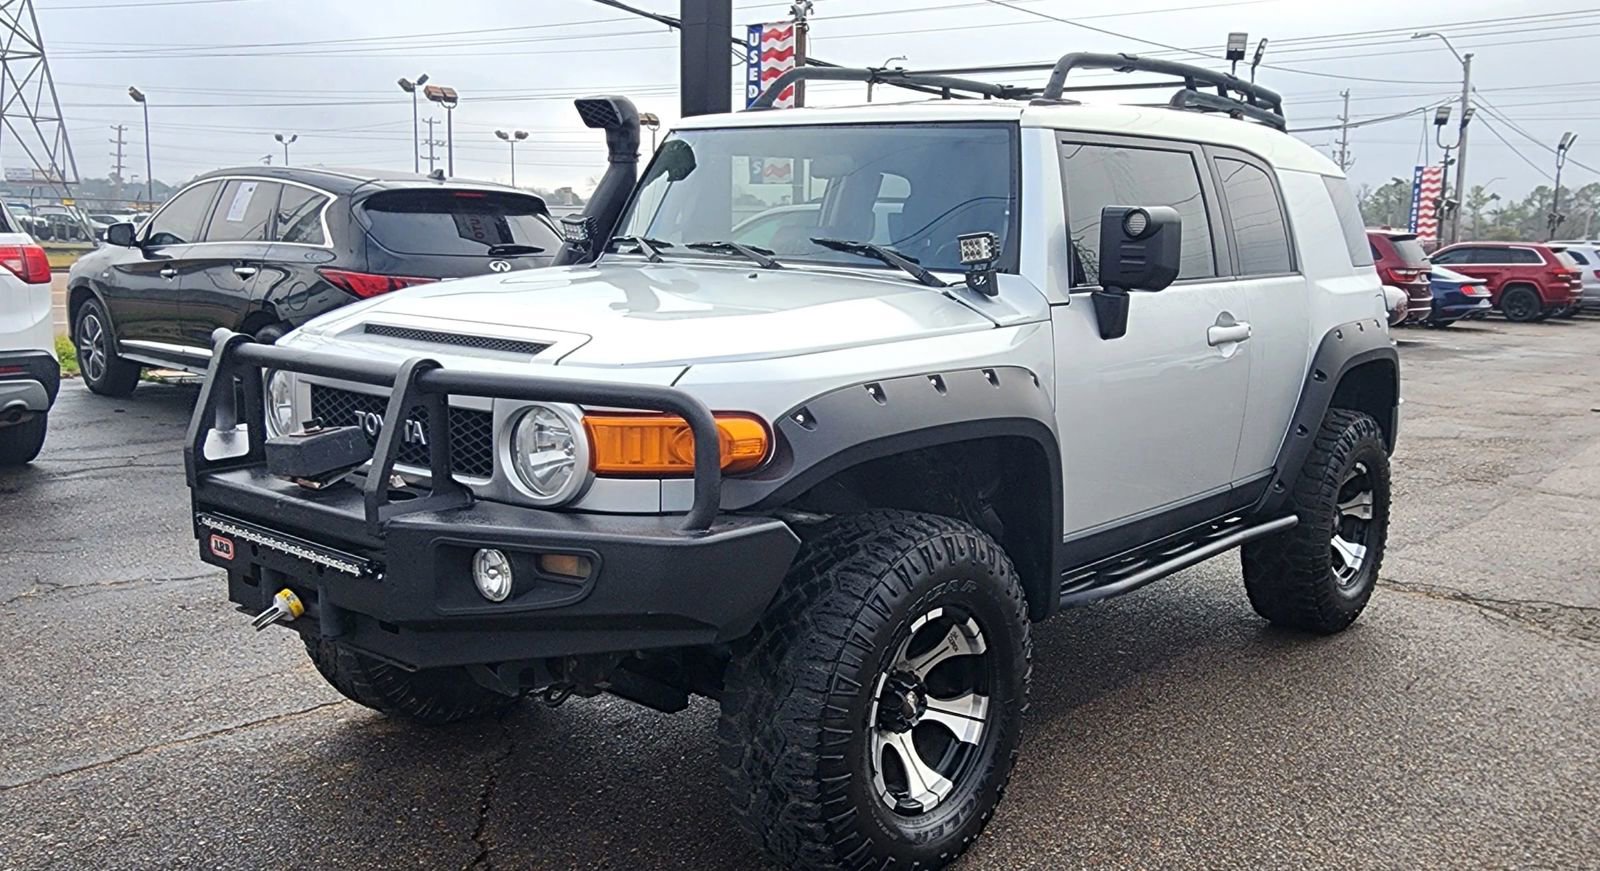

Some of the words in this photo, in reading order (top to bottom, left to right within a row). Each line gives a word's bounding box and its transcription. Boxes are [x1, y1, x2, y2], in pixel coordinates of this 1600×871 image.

[748, 32, 760, 99] USED
[354, 410, 427, 446] TOTA
[214, 539, 231, 554] ARB
